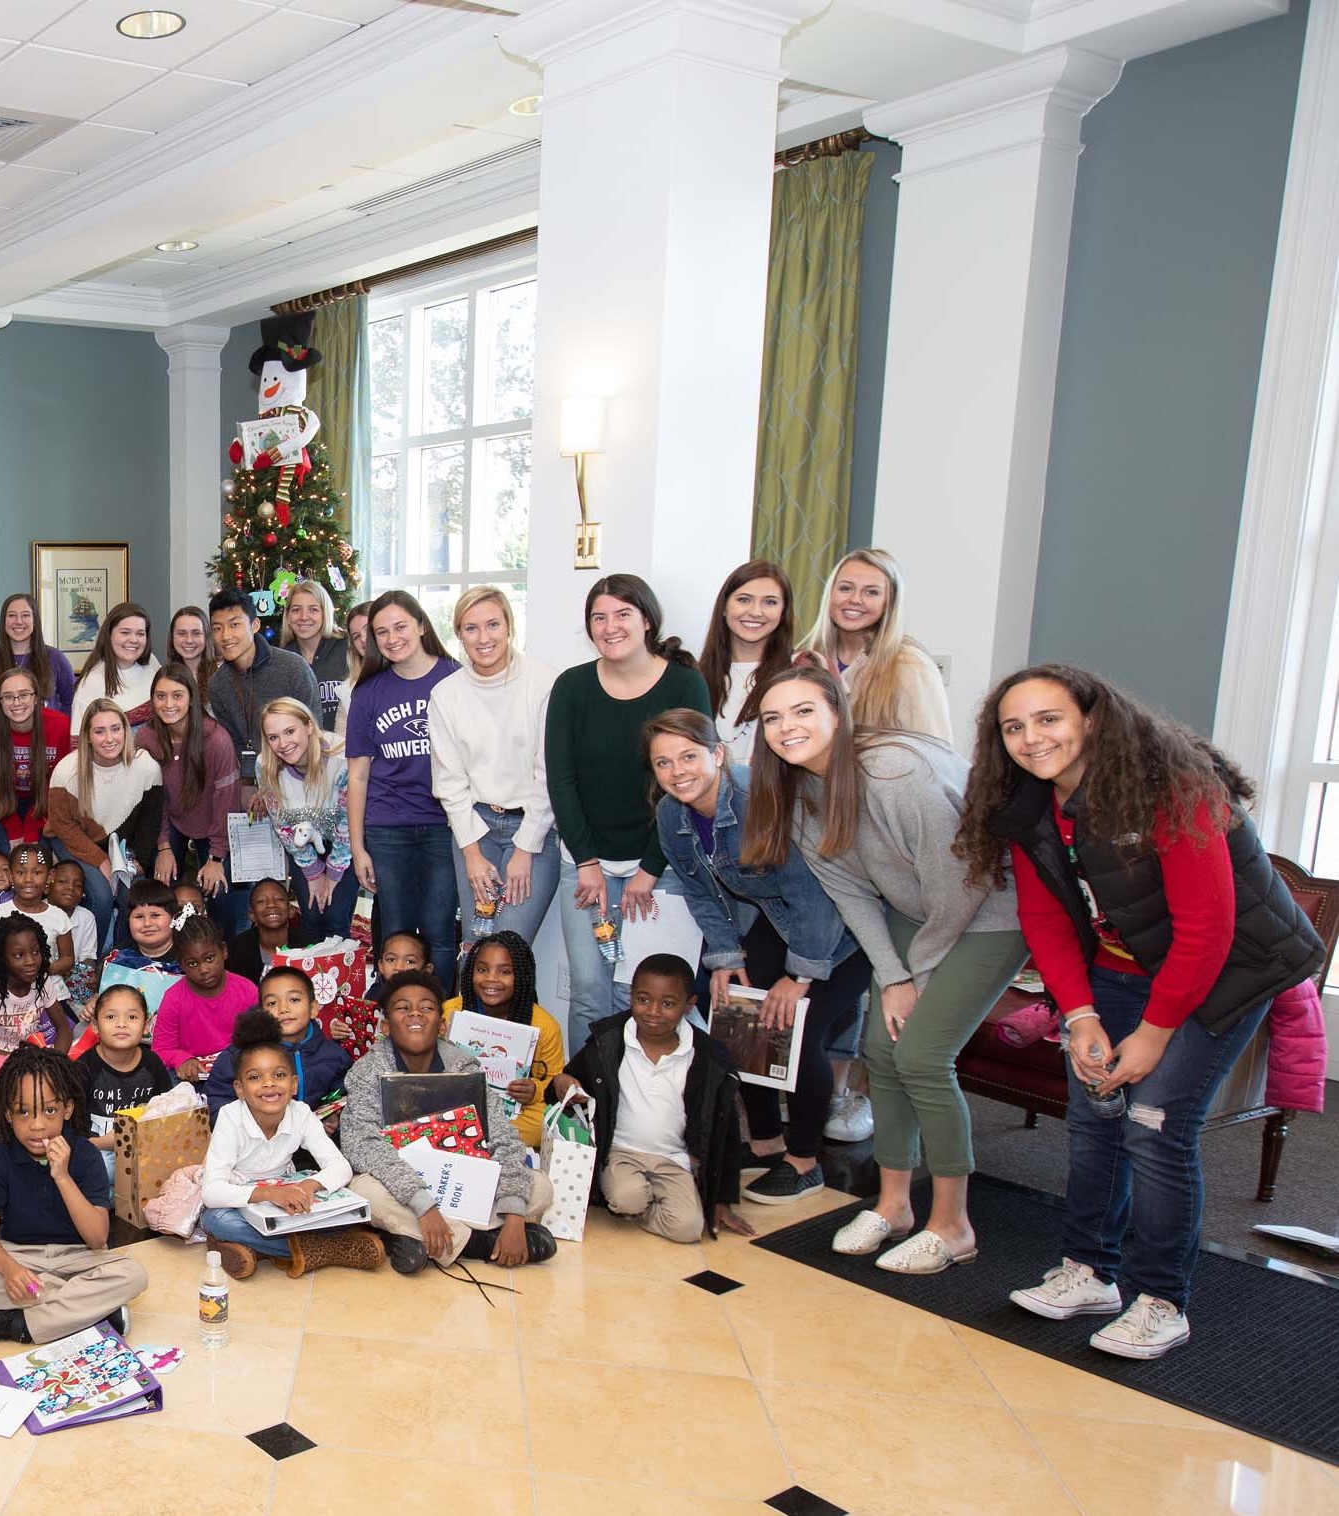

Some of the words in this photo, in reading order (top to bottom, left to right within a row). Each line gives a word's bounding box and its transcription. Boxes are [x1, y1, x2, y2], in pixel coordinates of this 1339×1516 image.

[59, 576, 82, 585] MOBY
[84, 576, 103, 584] DICK
[376, 702, 413, 734] HIGH
[381, 739, 430, 759] UNIVER
[93, 1088, 122, 1101] COME
[131, 1087, 153, 1099] SIT
[437, 1163, 453, 1195] BAKER'S
[449, 1182, 464, 1208] BOOK!
